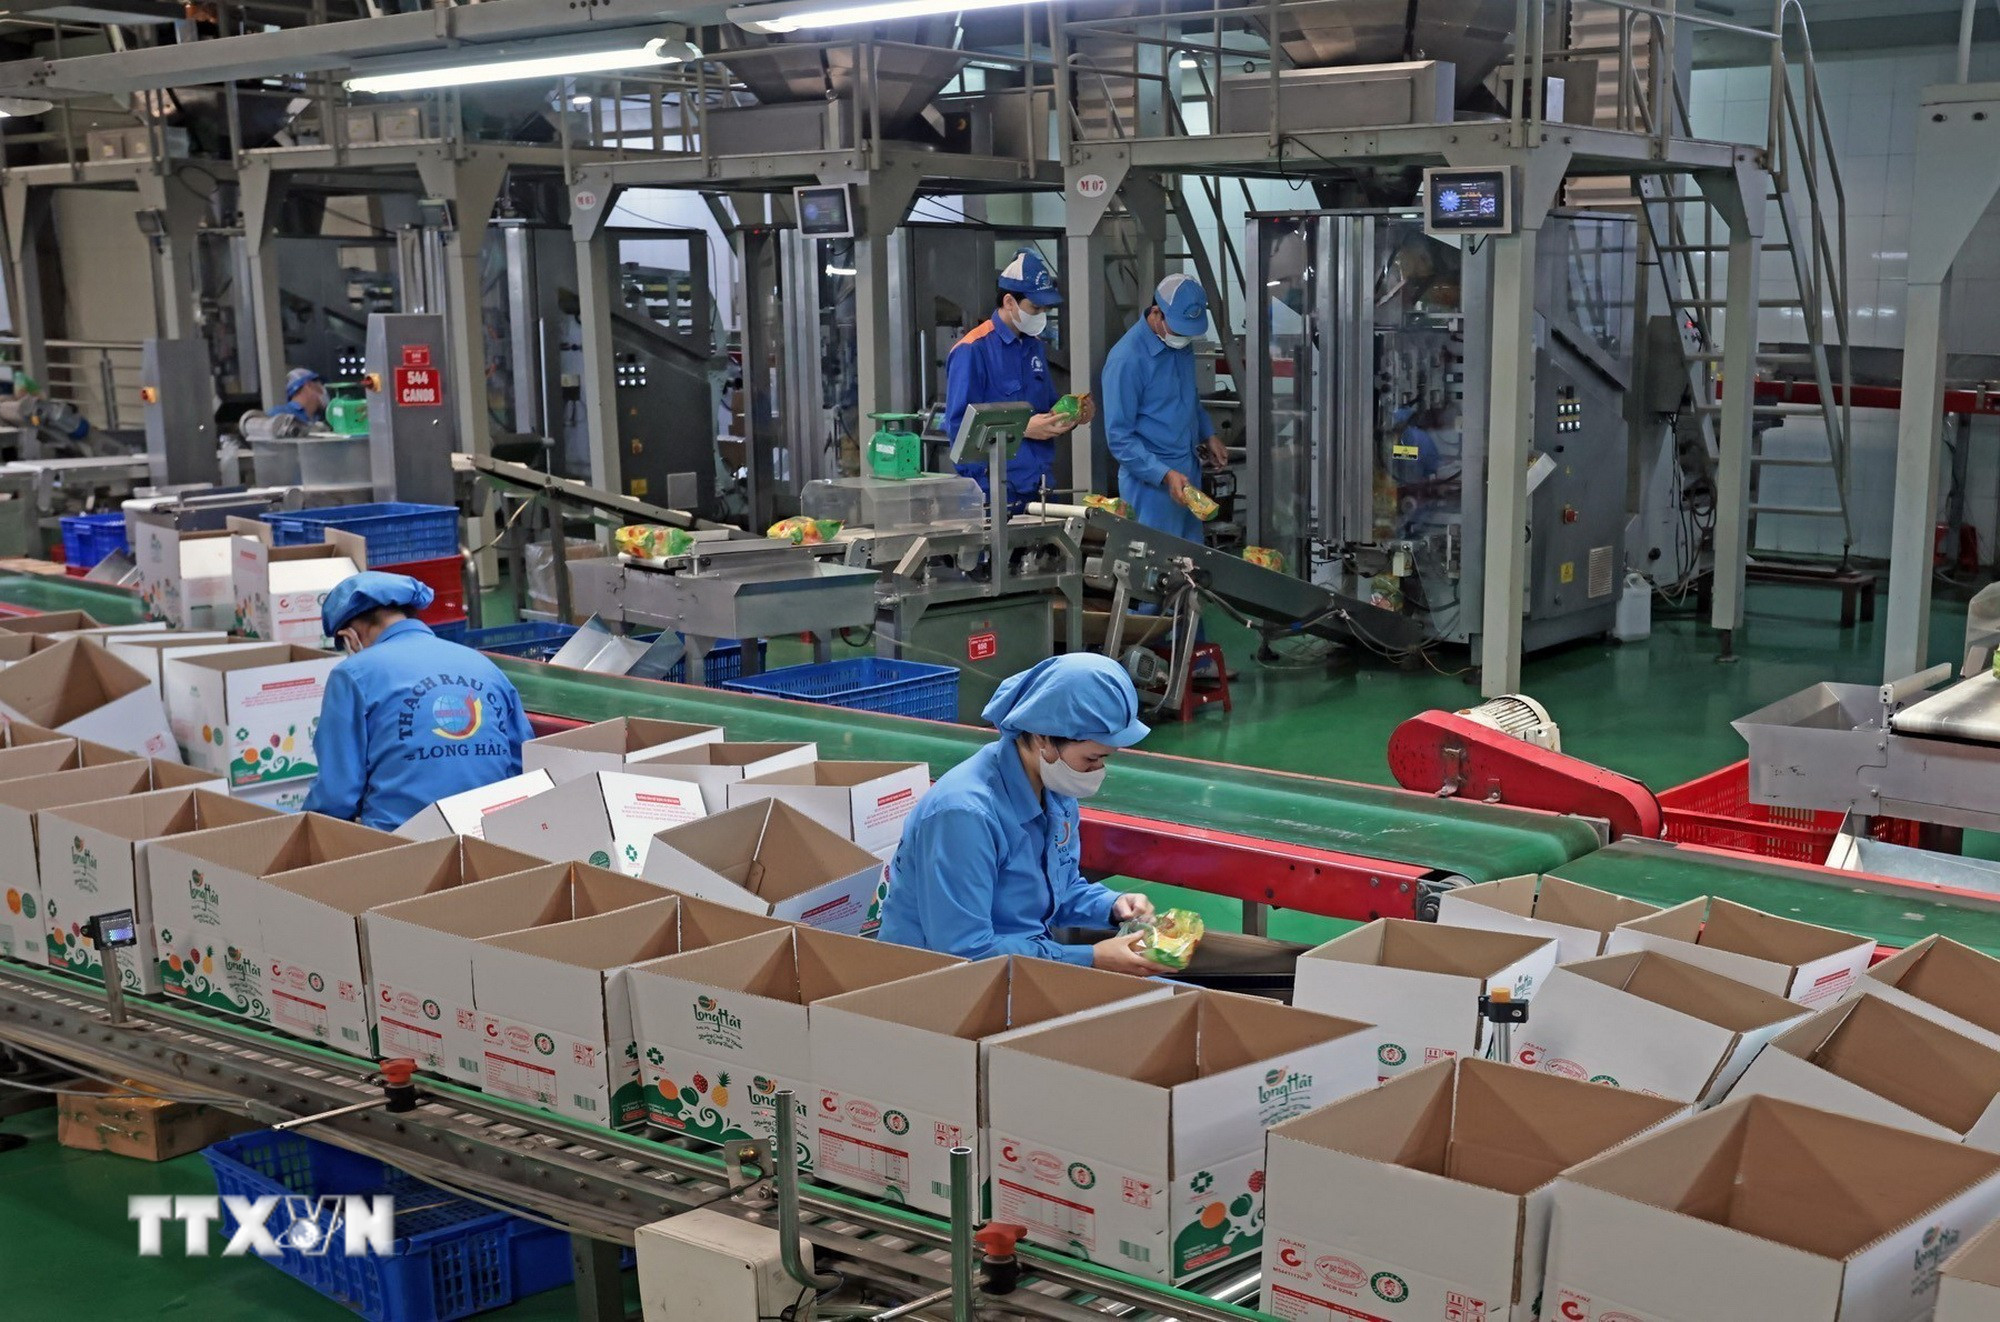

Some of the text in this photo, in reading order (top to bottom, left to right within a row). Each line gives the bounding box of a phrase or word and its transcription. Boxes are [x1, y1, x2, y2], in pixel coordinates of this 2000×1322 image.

[1080, 180, 1104, 191] M 07
[407, 371, 429, 385] 544
[438, 673, 485, 692] RAU
[418, 743, 470, 761] LONG
